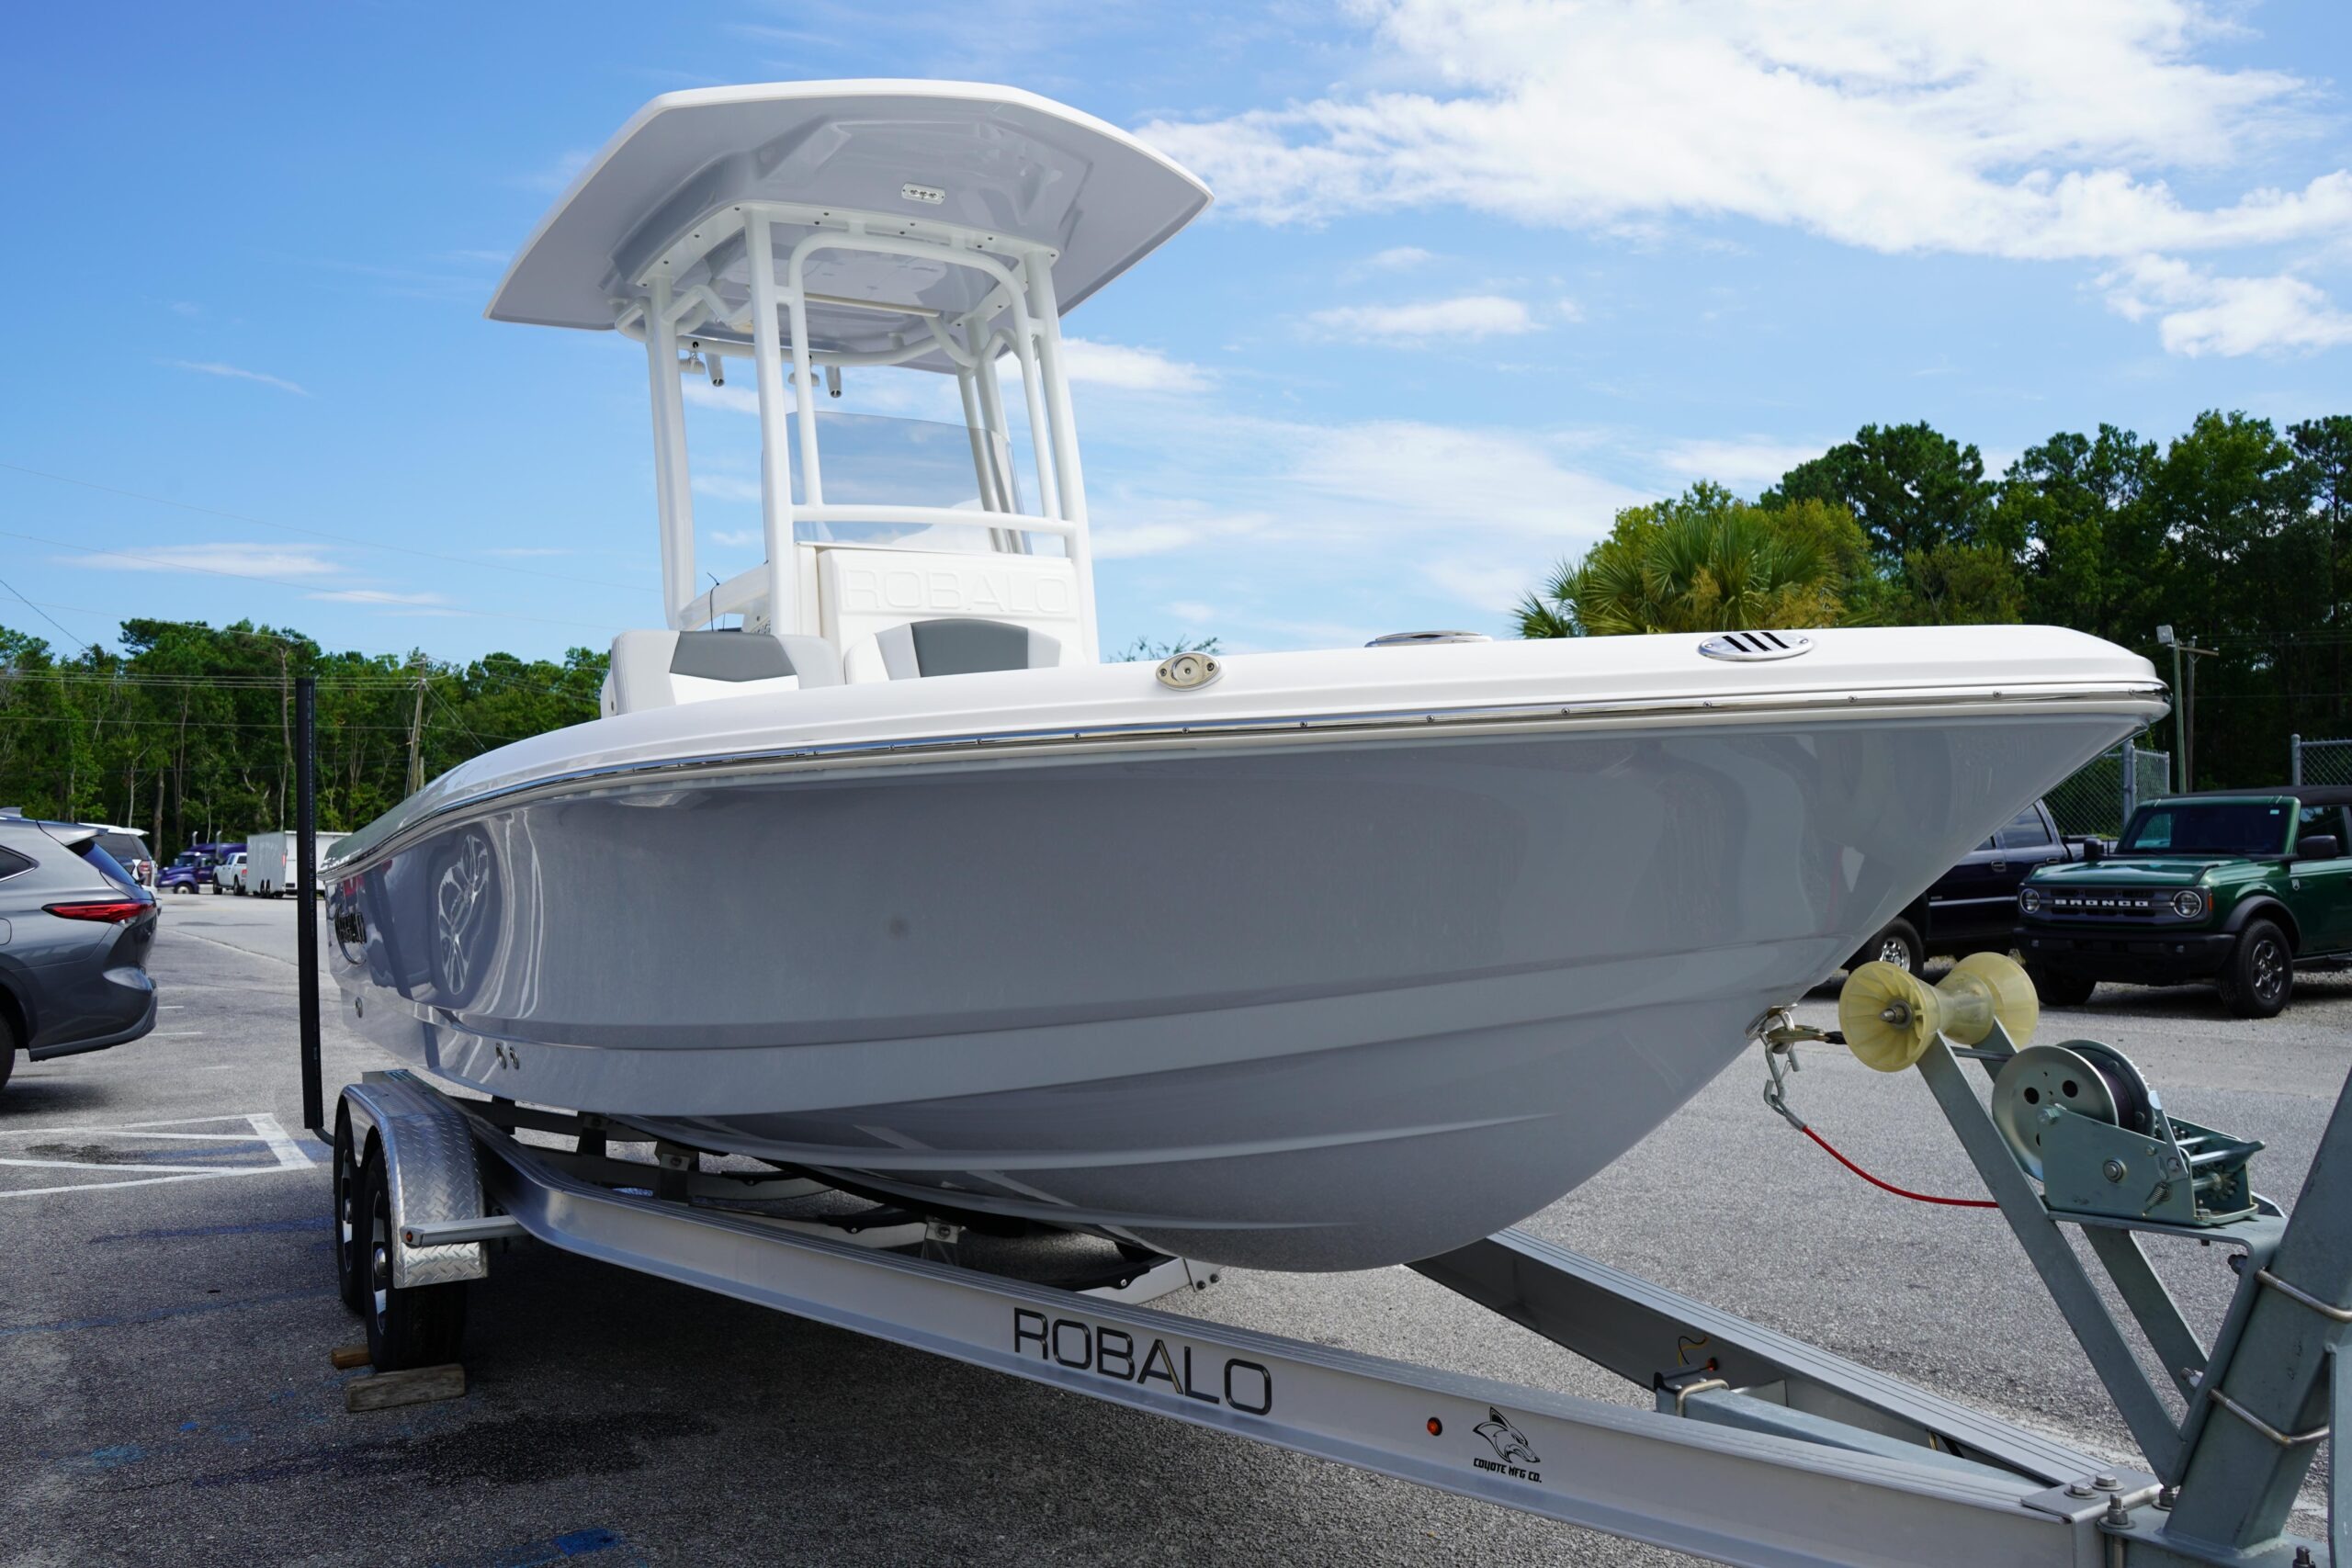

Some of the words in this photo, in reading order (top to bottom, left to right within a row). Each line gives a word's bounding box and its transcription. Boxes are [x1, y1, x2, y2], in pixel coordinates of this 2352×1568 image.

[844, 570, 1069, 614] ROBALO
[1013, 1306, 1272, 1416] ROBALO
[1473, 1458, 1507, 1474] COYOTE
[1509, 1466, 1527, 1480] MFG
[1528, 1472, 1543, 1483] CO.
